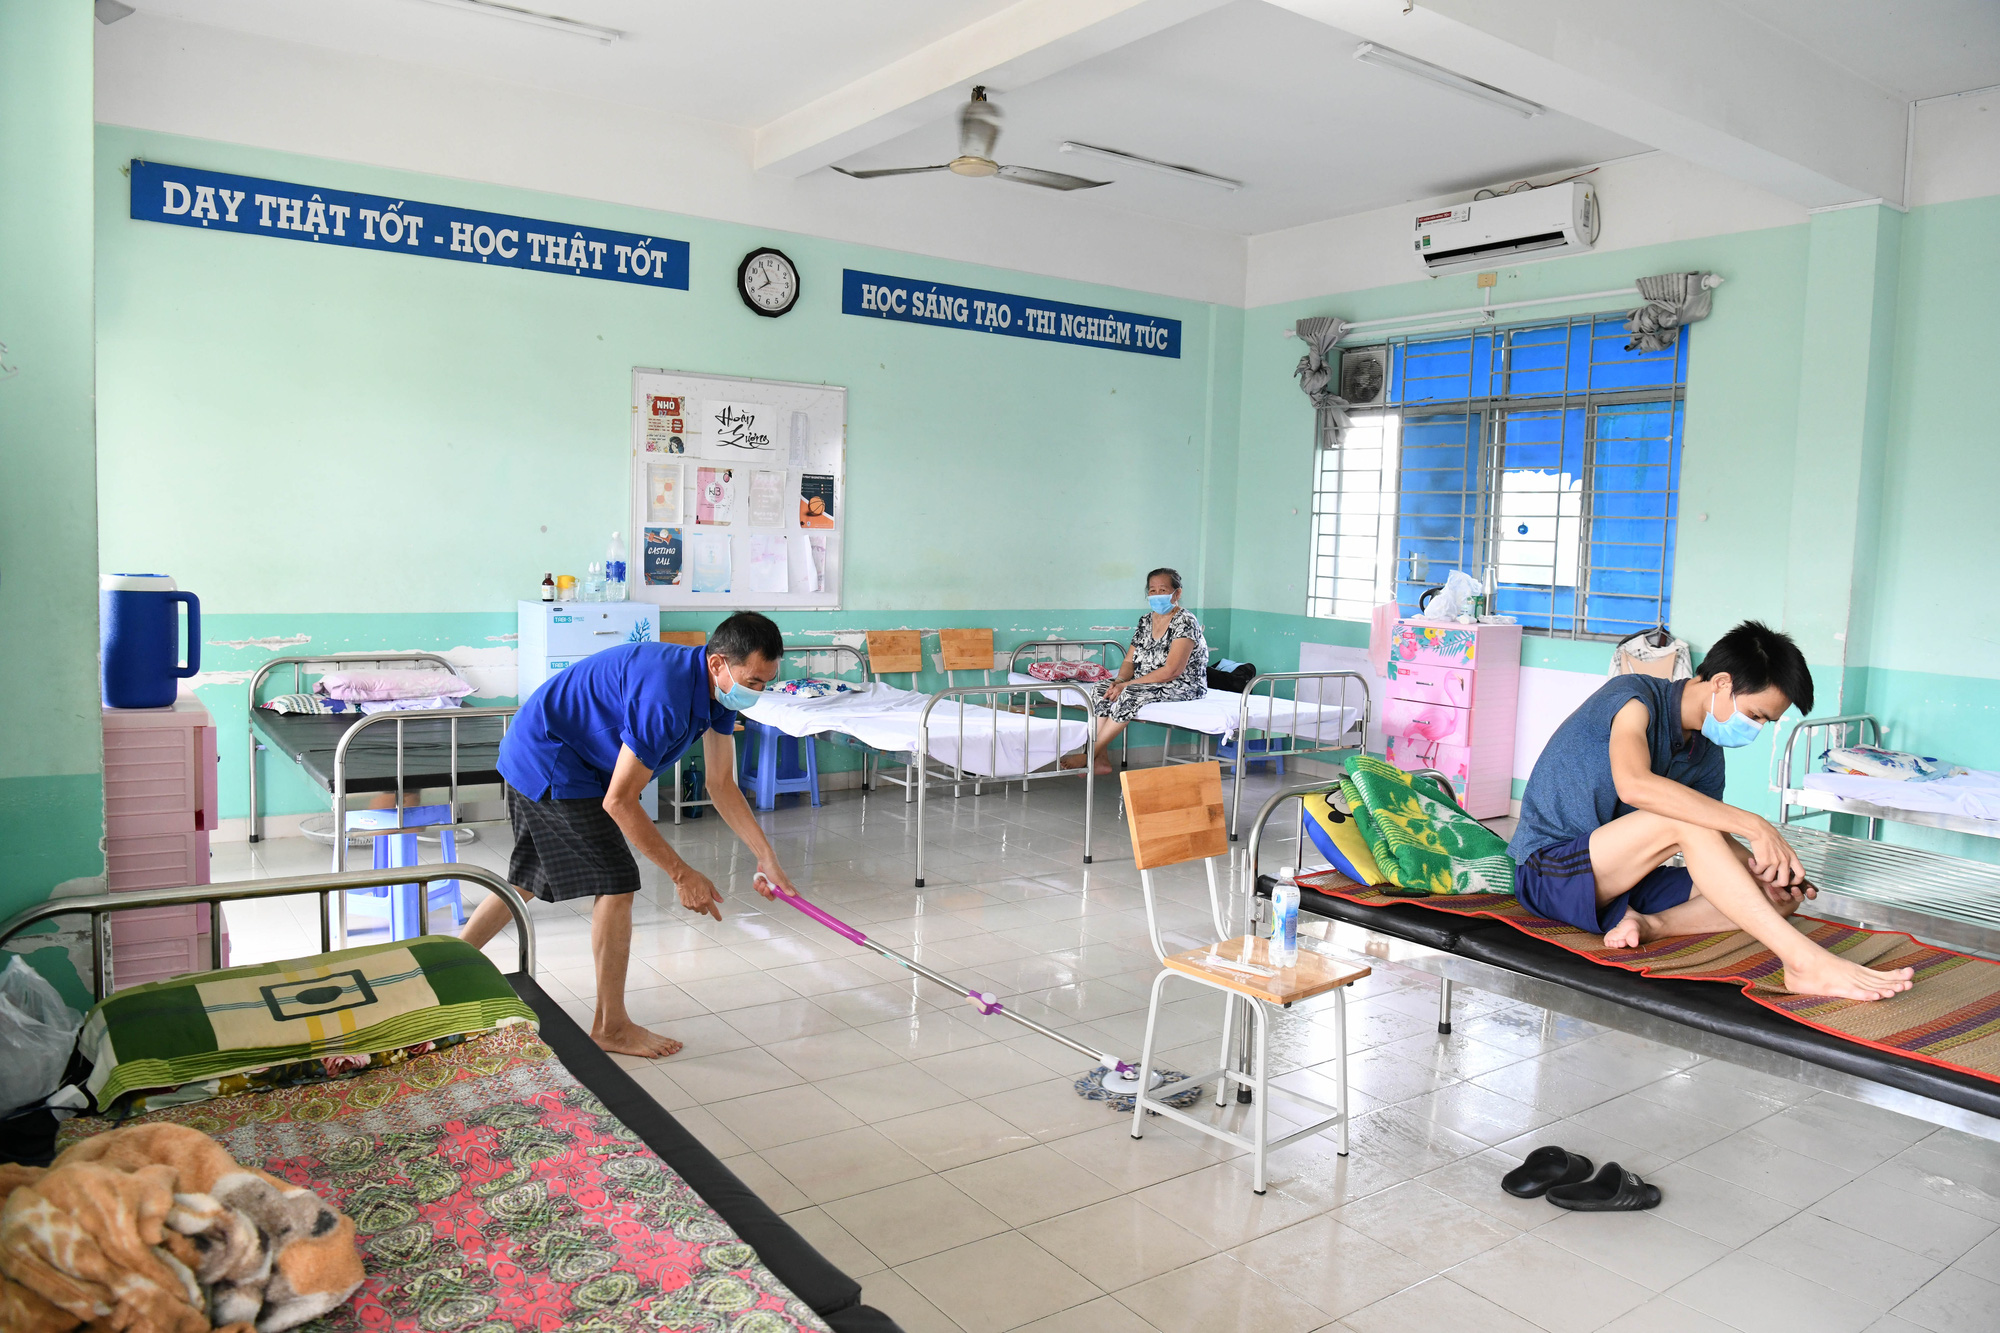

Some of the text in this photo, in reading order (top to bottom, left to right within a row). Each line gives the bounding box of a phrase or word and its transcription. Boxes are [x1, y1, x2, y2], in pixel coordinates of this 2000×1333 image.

[162, 180, 245, 227] DẠY
[255, 193, 350, 242] THẬT
[359, 201, 423, 247] TỐT
[450, 221, 518, 263] HỌC
[526, 231, 607, 275] THẬT
[613, 237, 668, 280] TỐT
[861, 283, 907, 317] HỌC
[912, 287, 969, 323] SÁNG
[973, 299, 1012, 332] TẠO
[1025, 308, 1056, 335] THI
[1059, 314, 1132, 345] NGHIÊM
[1134, 320, 1169, 350] TÚC
[655, 557, 671, 565] CALL
